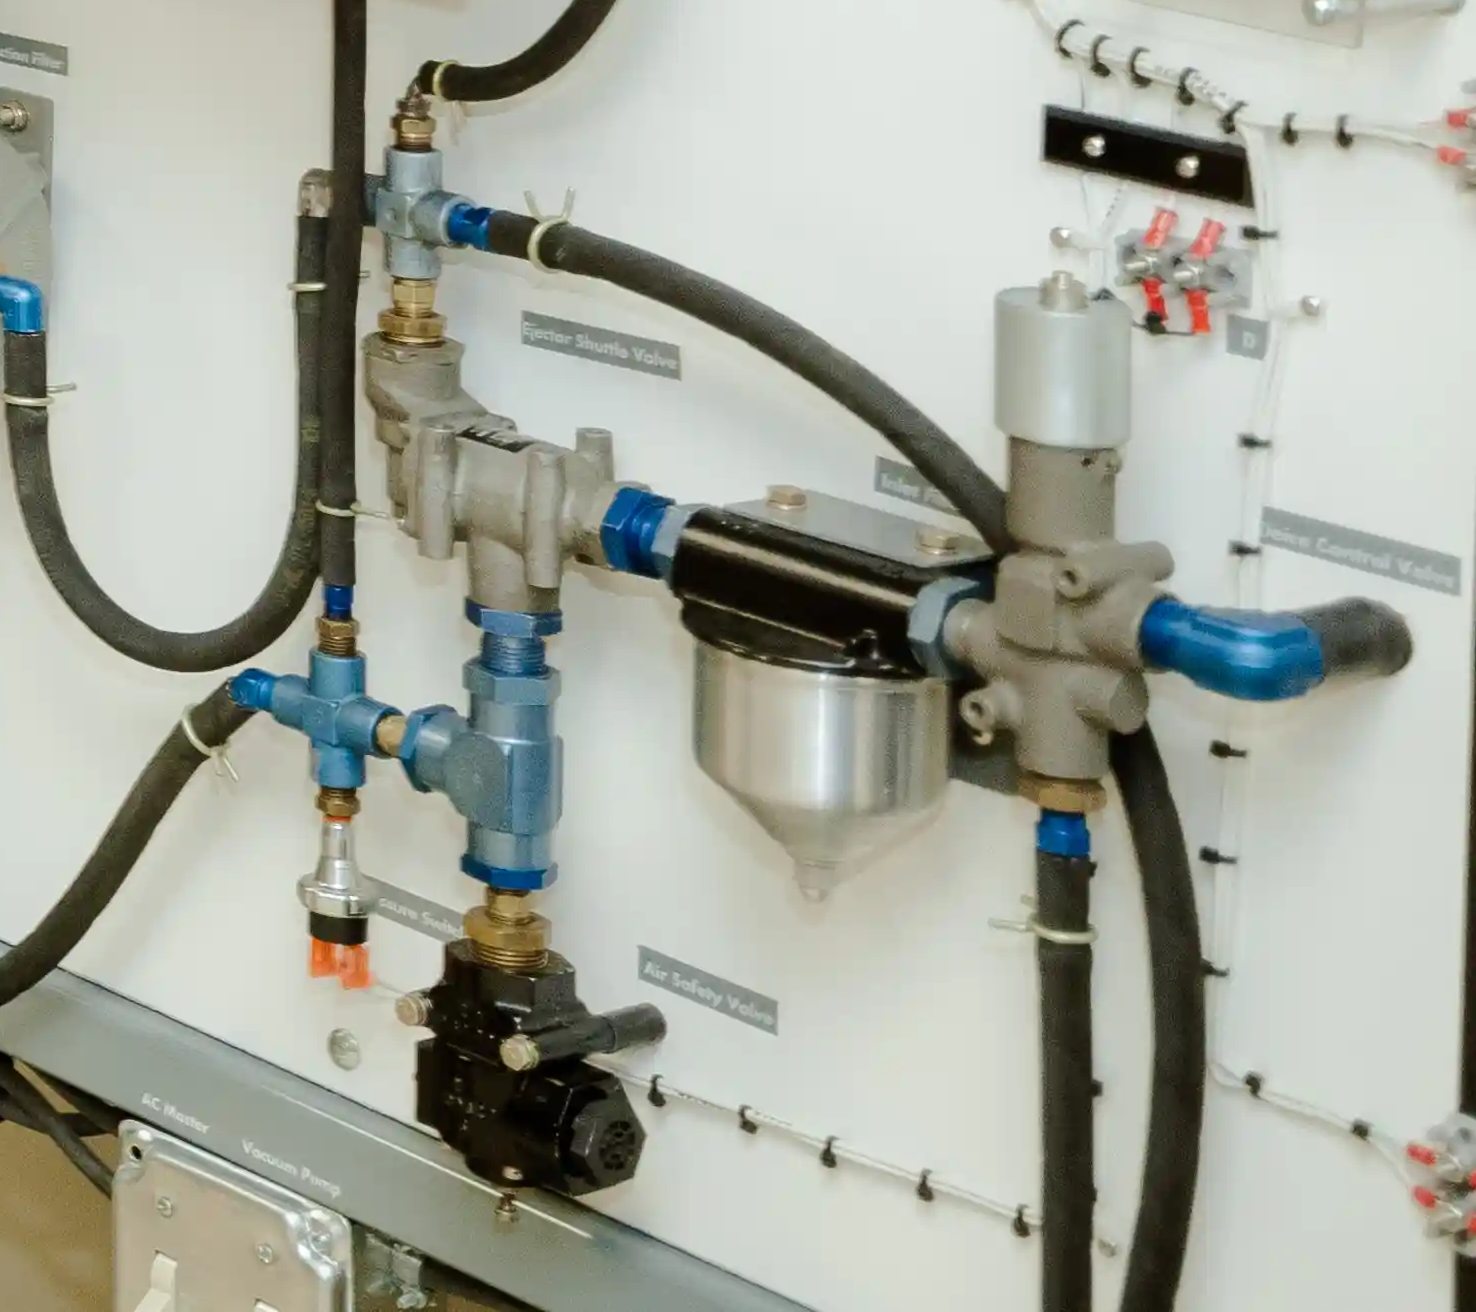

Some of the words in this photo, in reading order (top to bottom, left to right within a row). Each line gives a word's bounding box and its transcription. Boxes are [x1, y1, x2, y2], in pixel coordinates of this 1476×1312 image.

[523, 321, 574, 345] Ejector
[574, 333, 630, 359] Shuttle
[631, 346, 678, 370] Valve
[1315, 536, 1393, 571] Control
[642, 960, 668, 982] Air
[671, 970, 724, 1008] Safety
[726, 993, 775, 1026] Valve
[141, 1091, 163, 1112] AC
[163, 1101, 211, 1135] Master
[241, 1137, 299, 1177] Vacuum
[300, 1163, 343, 1201] Pump
